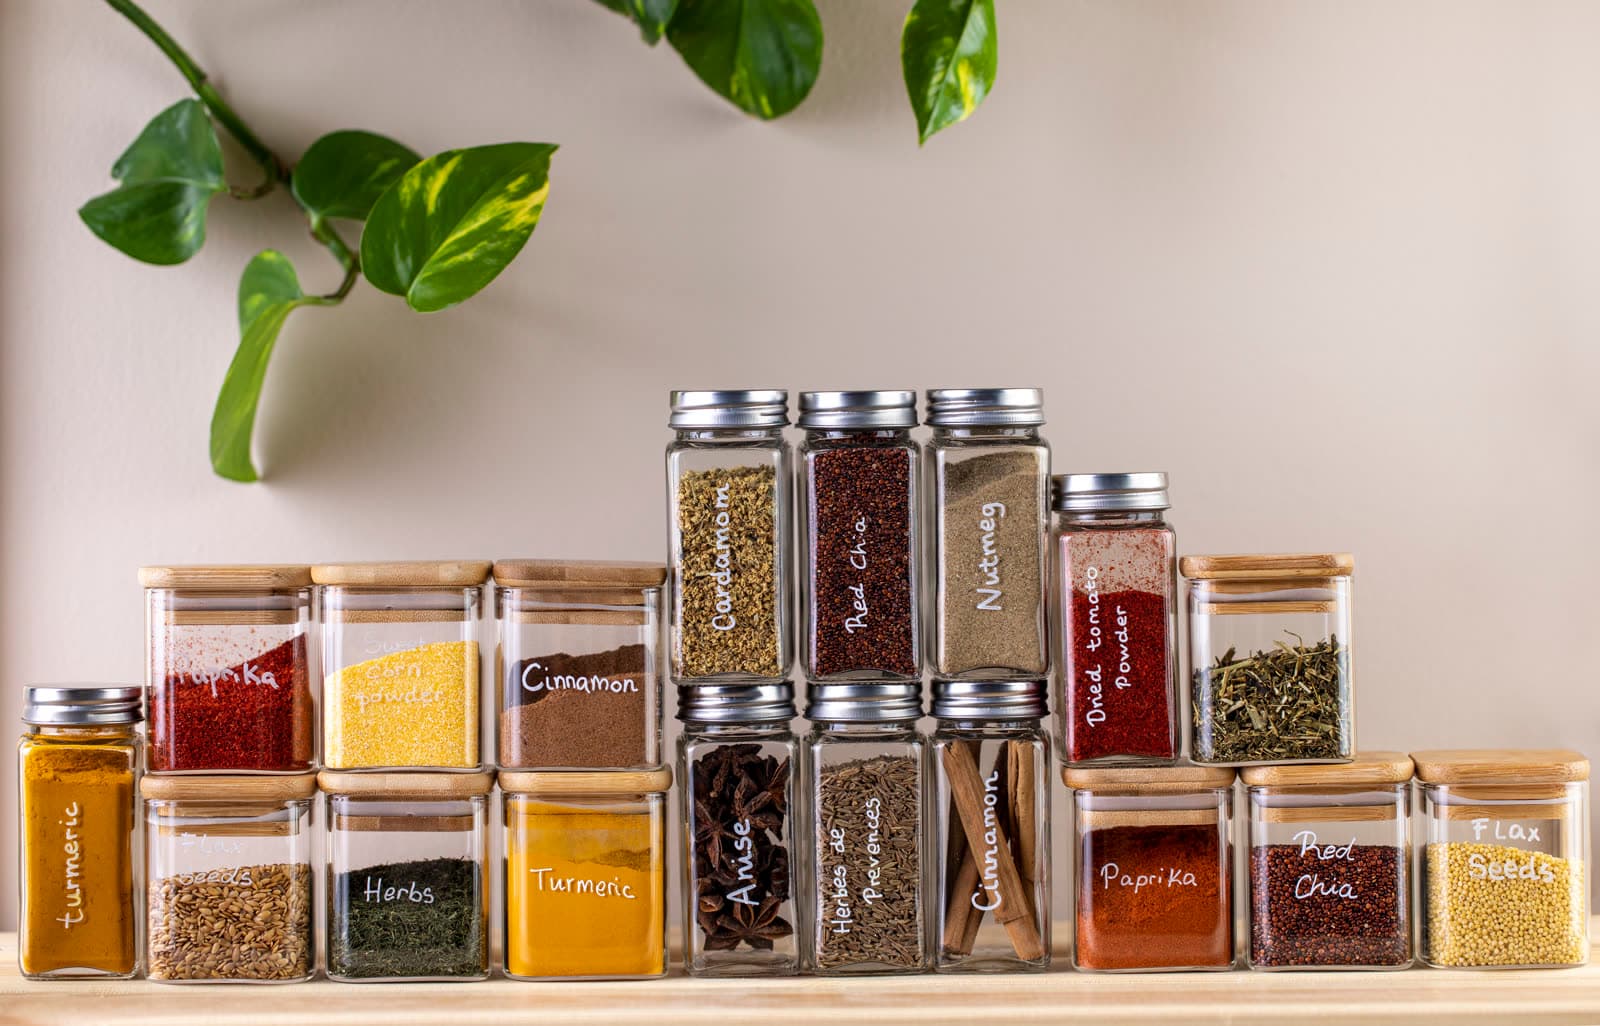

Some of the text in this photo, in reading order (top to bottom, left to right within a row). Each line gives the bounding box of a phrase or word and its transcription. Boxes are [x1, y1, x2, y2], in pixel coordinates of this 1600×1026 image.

[712, 483, 736, 631] Cardamom
[845, 516, 868, 633] Red Chia
[976, 501, 1006, 612] Nutmeg
[521, 662, 639, 694] Cinnamon
[1086, 566, 1106, 728] Dried tomato
[56, 801, 81, 930] turmeric
[364, 876, 435, 904] Herbs
[529, 867, 637, 900] Turmeric
[726, 818, 760, 906] Anise
[830, 827, 853, 935] Herbes de
[862, 797, 883, 905] Prevences
[971, 770, 1001, 912] Cinnamon
[1293, 830, 1356, 862] Red
[1295, 874, 1359, 901] Chia
[1468, 853, 1555, 883] Seeds
